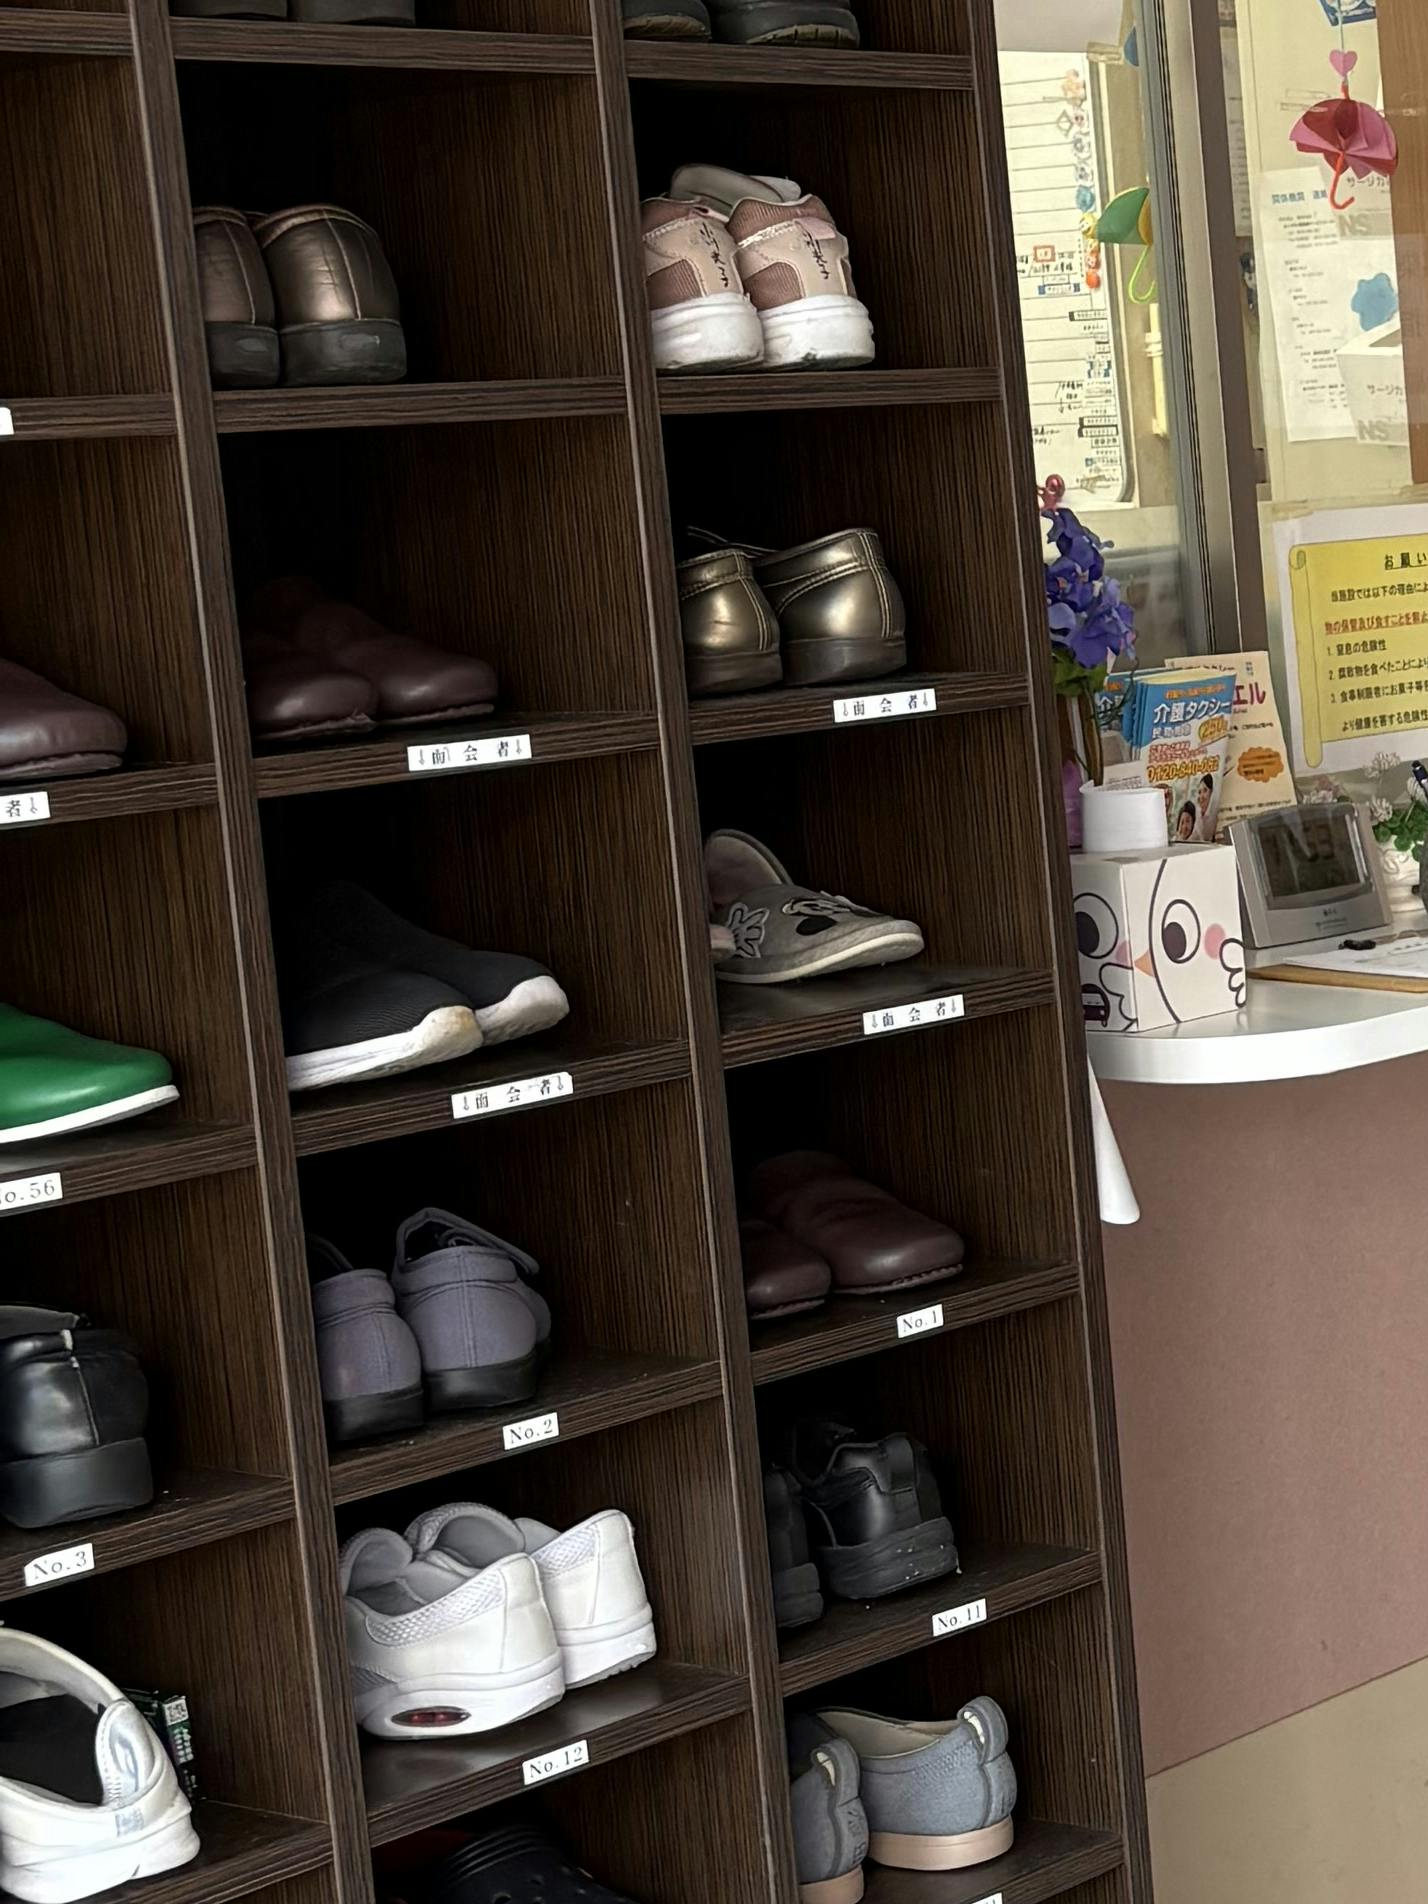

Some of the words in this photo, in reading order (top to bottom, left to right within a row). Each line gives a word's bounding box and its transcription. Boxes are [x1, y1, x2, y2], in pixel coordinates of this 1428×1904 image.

[1384, 551, 1428, 571] お願い
[853, 694, 919, 717] 面会者
[1153, 699, 1232, 725] 介護タクシー
[882, 1001, 947, 1028] 面会者
[0, 1181, 56, 1205] o.56
[901, 1309, 938, 1331] No.1
[508, 1418, 554, 1442] No.2
[32, 1550, 88, 1575] No.3
[937, 1604, 981, 1629] No.11
[528, 1745, 584, 1776] No.12
